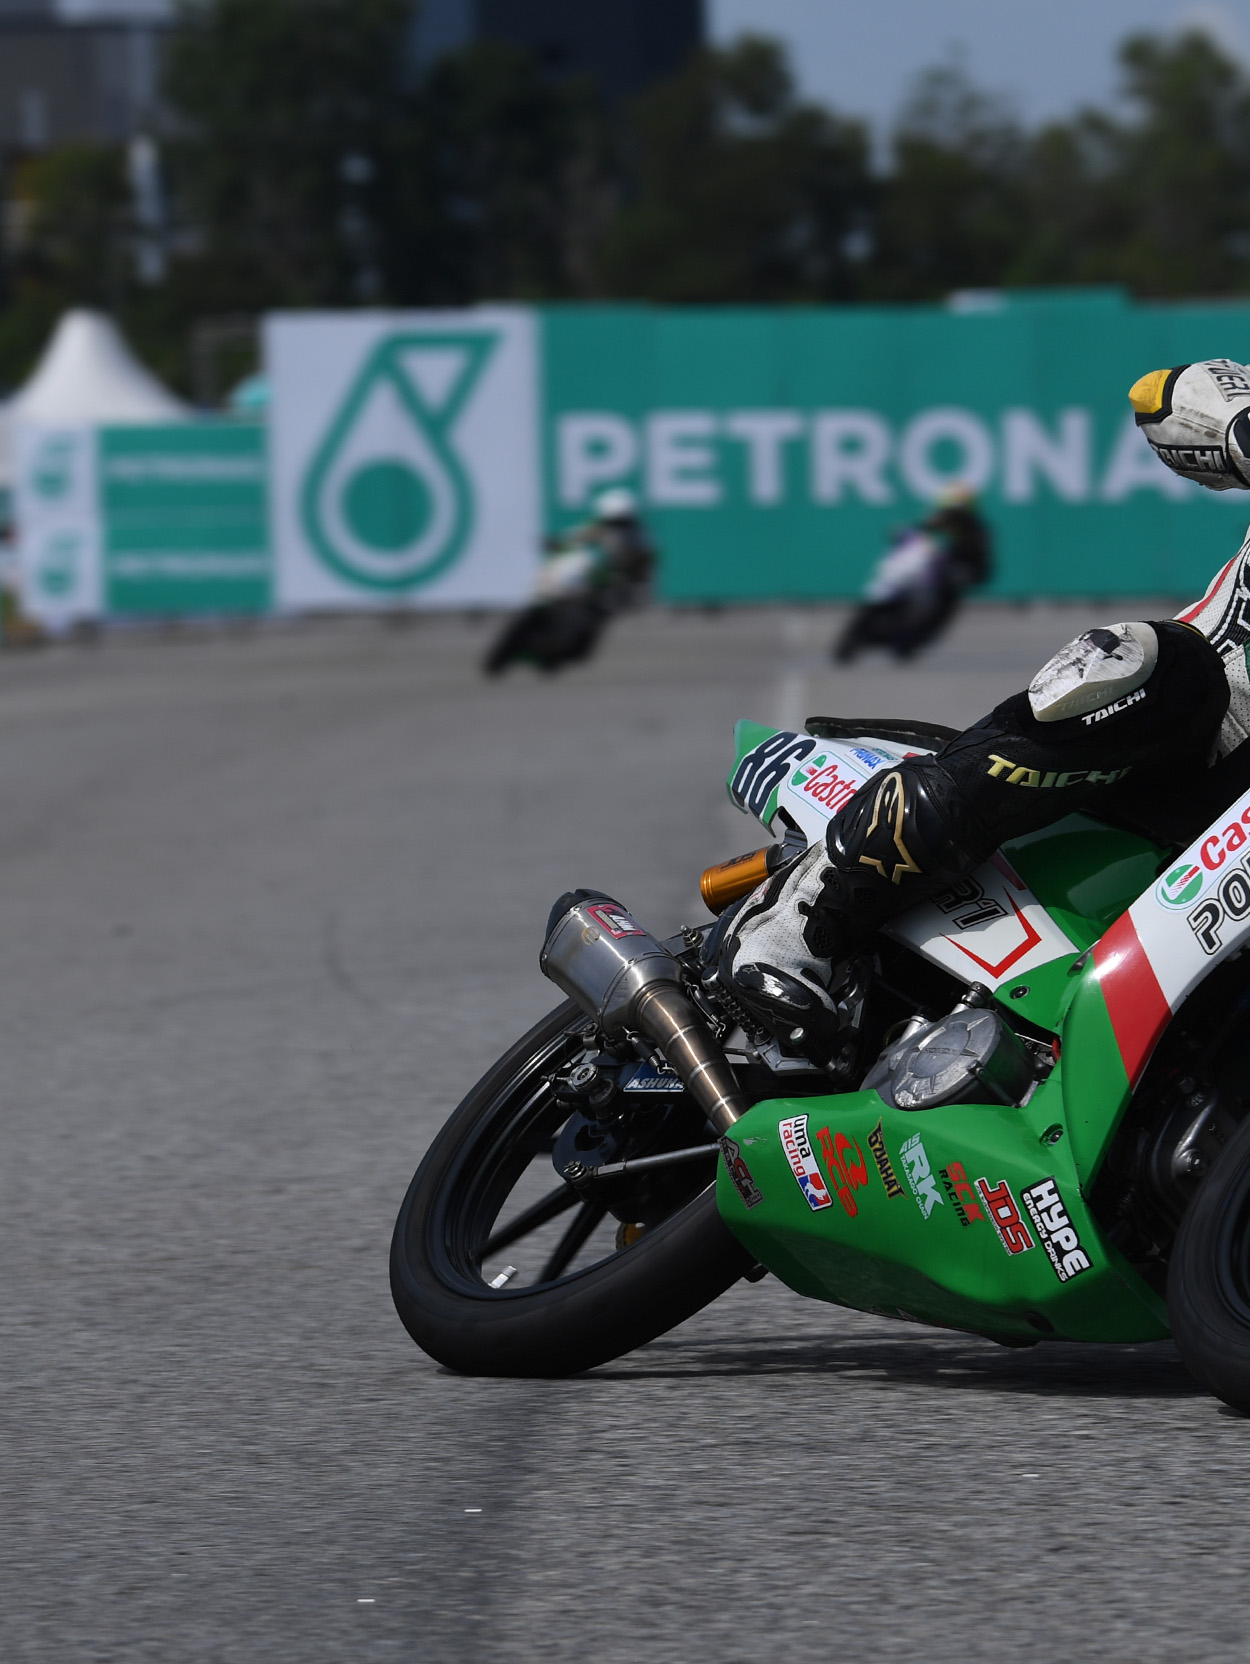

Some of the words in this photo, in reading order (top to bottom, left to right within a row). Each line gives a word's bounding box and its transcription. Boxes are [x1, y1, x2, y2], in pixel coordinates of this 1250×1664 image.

[1150, 444, 1227, 472] AICHI
[1081, 688, 1147, 726] TAICHI
[732, 731, 817, 817] 86
[987, 754, 1132, 788] TAICHI
[783, 1122, 806, 1177] racing
[794, 1117, 811, 1159] uma
[900, 1155, 917, 1195] TAKASAGO
[915, 1196, 929, 1220] CHAIN
[905, 1142, 945, 1217] RK
[946, 1162, 986, 1224] SCK
[978, 1178, 1034, 1254] JDS
[1023, 1192, 1049, 1239] ENERGY
[1044, 1241, 1069, 1282] DRINKS
[1030, 1180, 1091, 1277] HYPE
